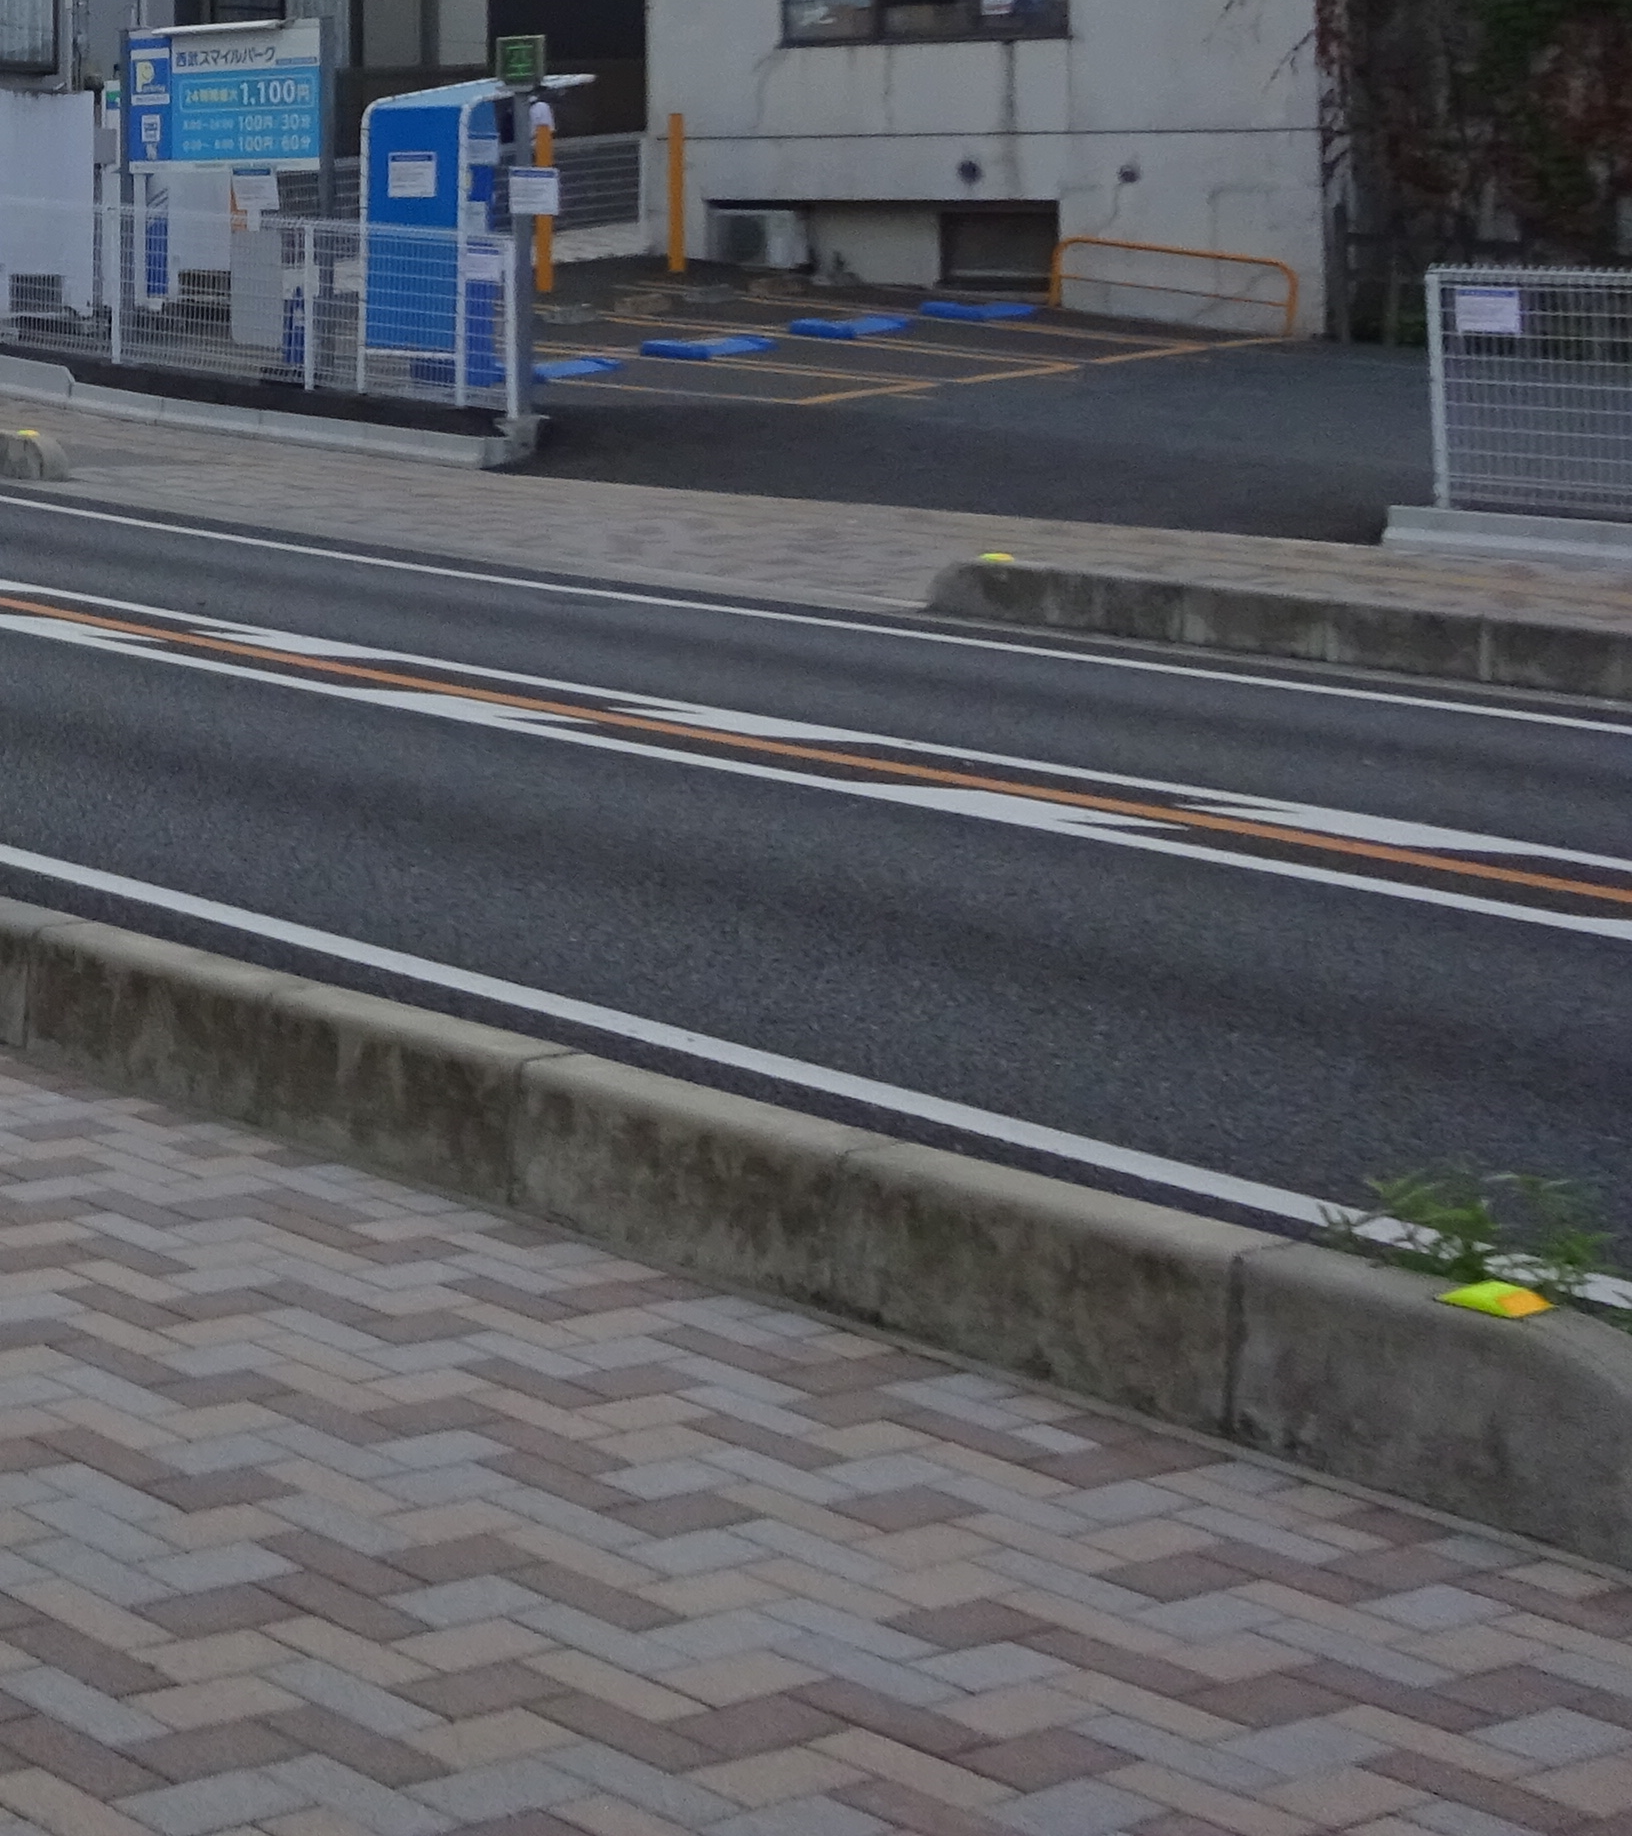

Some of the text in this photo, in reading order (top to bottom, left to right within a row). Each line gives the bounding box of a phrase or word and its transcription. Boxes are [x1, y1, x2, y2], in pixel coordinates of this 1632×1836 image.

[176, 46, 277, 67] 西武スマイルパーク
